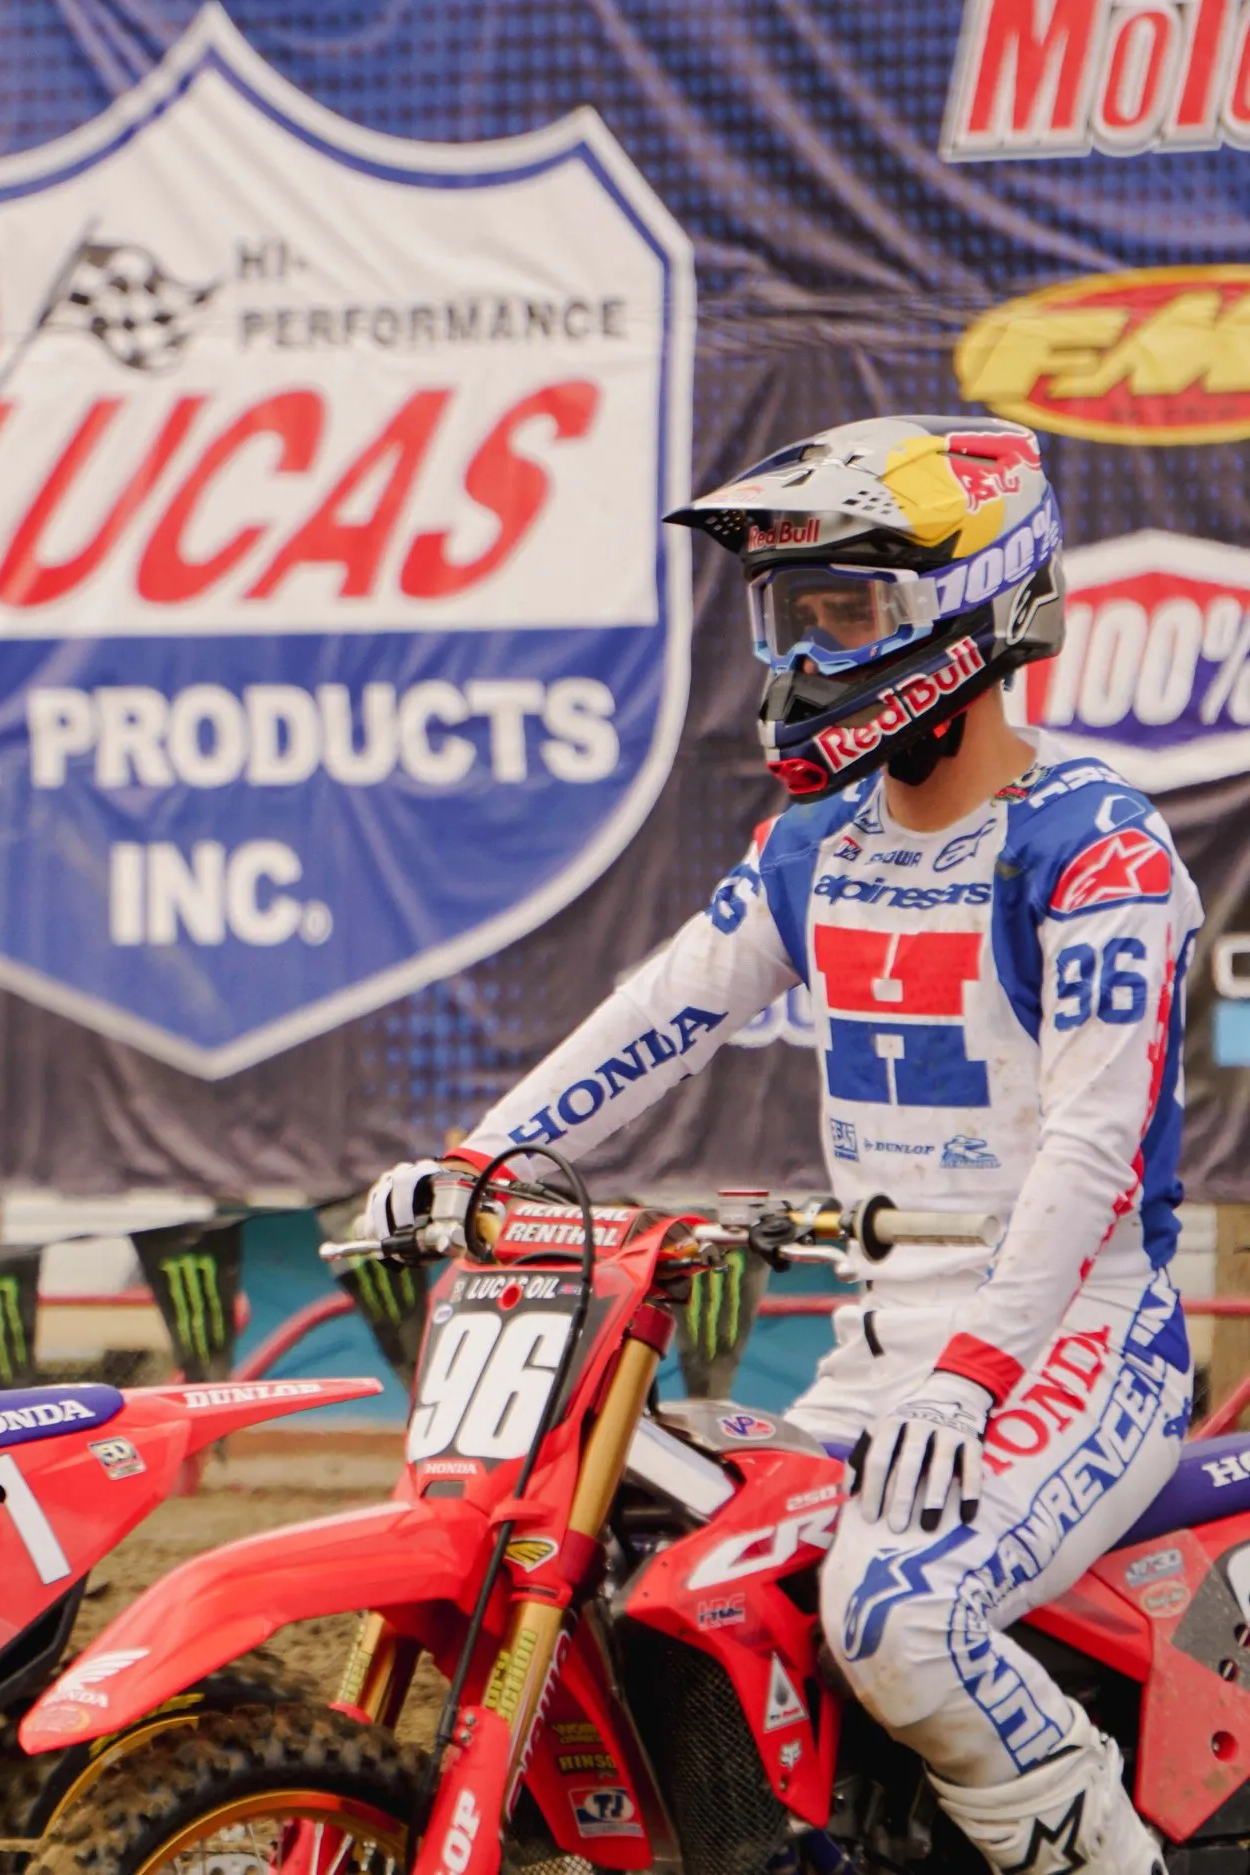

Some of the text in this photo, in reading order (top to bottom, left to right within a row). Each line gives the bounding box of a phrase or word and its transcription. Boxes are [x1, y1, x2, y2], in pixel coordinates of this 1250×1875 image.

[235, 239, 312, 281] HI-
[237, 299, 628, 350] PERFORMANCE
[748, 518, 821, 551] Red Bull
[816, 636, 986, 775] Red Bull
[27, 679, 621, 788] PRODUCTS
[1053, 937, 1149, 1033] 96
[875, 1141, 936, 1156] DUNLOP
[504, 1221, 619, 1247] RENTHAL
[526, 1275, 561, 1300] OIL
[183, 1384, 323, 1409] DUNLOP
[406, 1310, 573, 1463] 96
[423, 1462, 478, 1475] HONDA
[686, 1504, 840, 1591] CR
